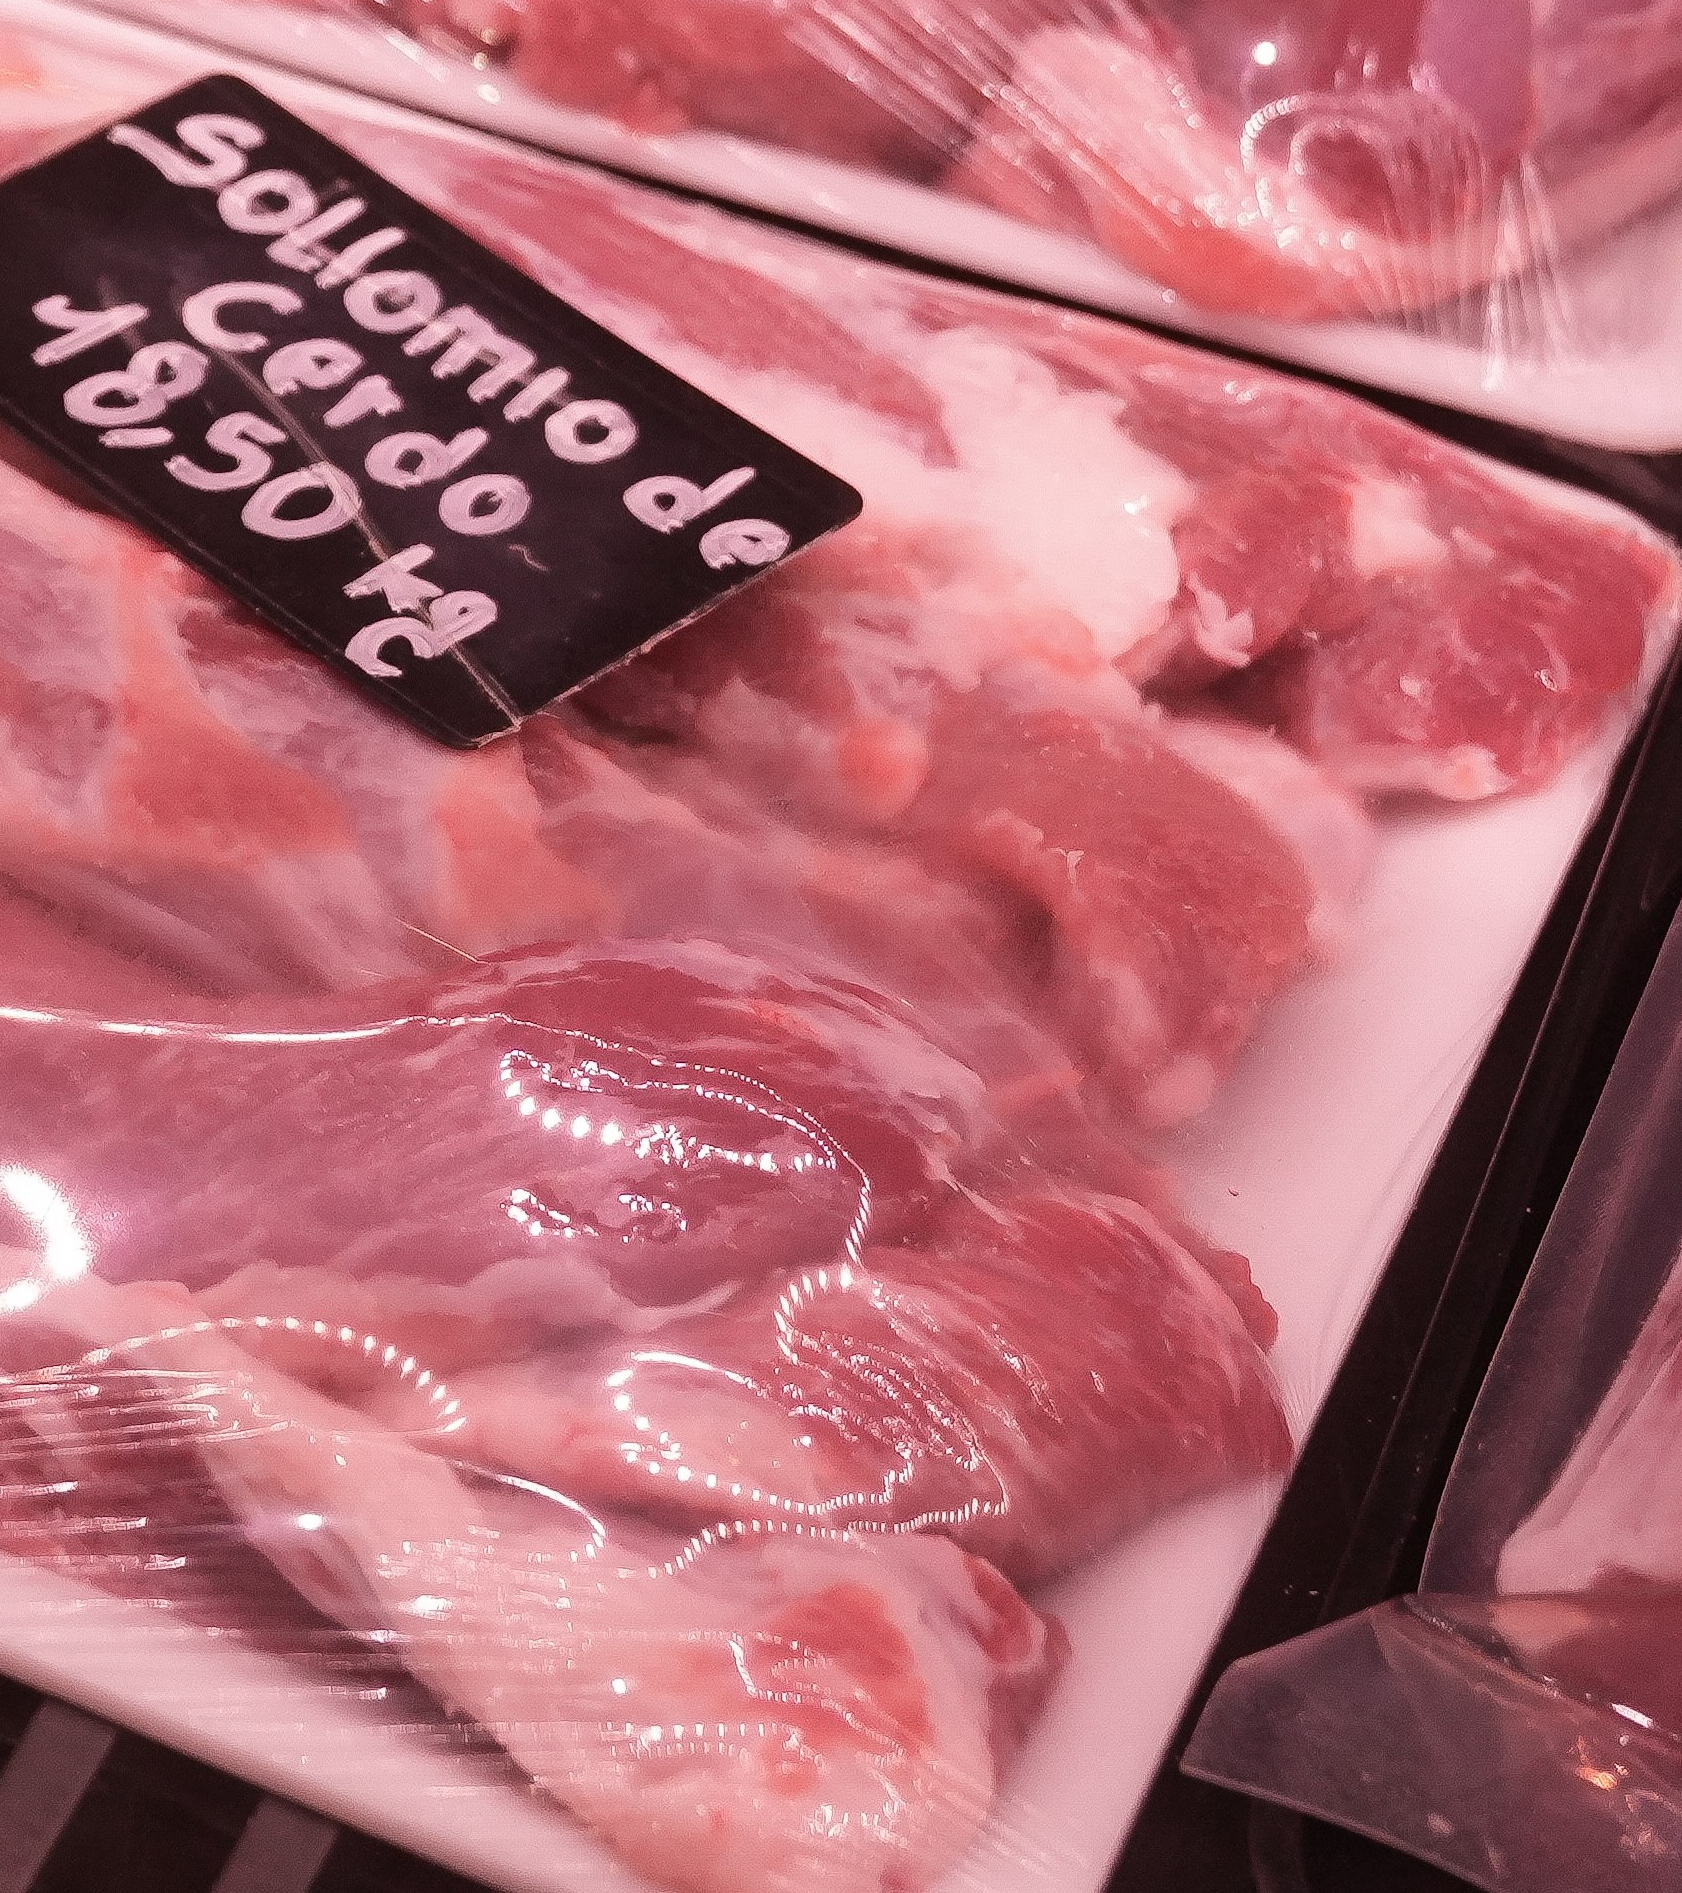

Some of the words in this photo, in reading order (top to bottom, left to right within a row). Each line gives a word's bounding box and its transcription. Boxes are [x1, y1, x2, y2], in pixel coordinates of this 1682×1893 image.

[32, 293, 360, 540] 18,50
[182, 281, 531, 535] Cerdo
[623, 467, 790, 570] de
